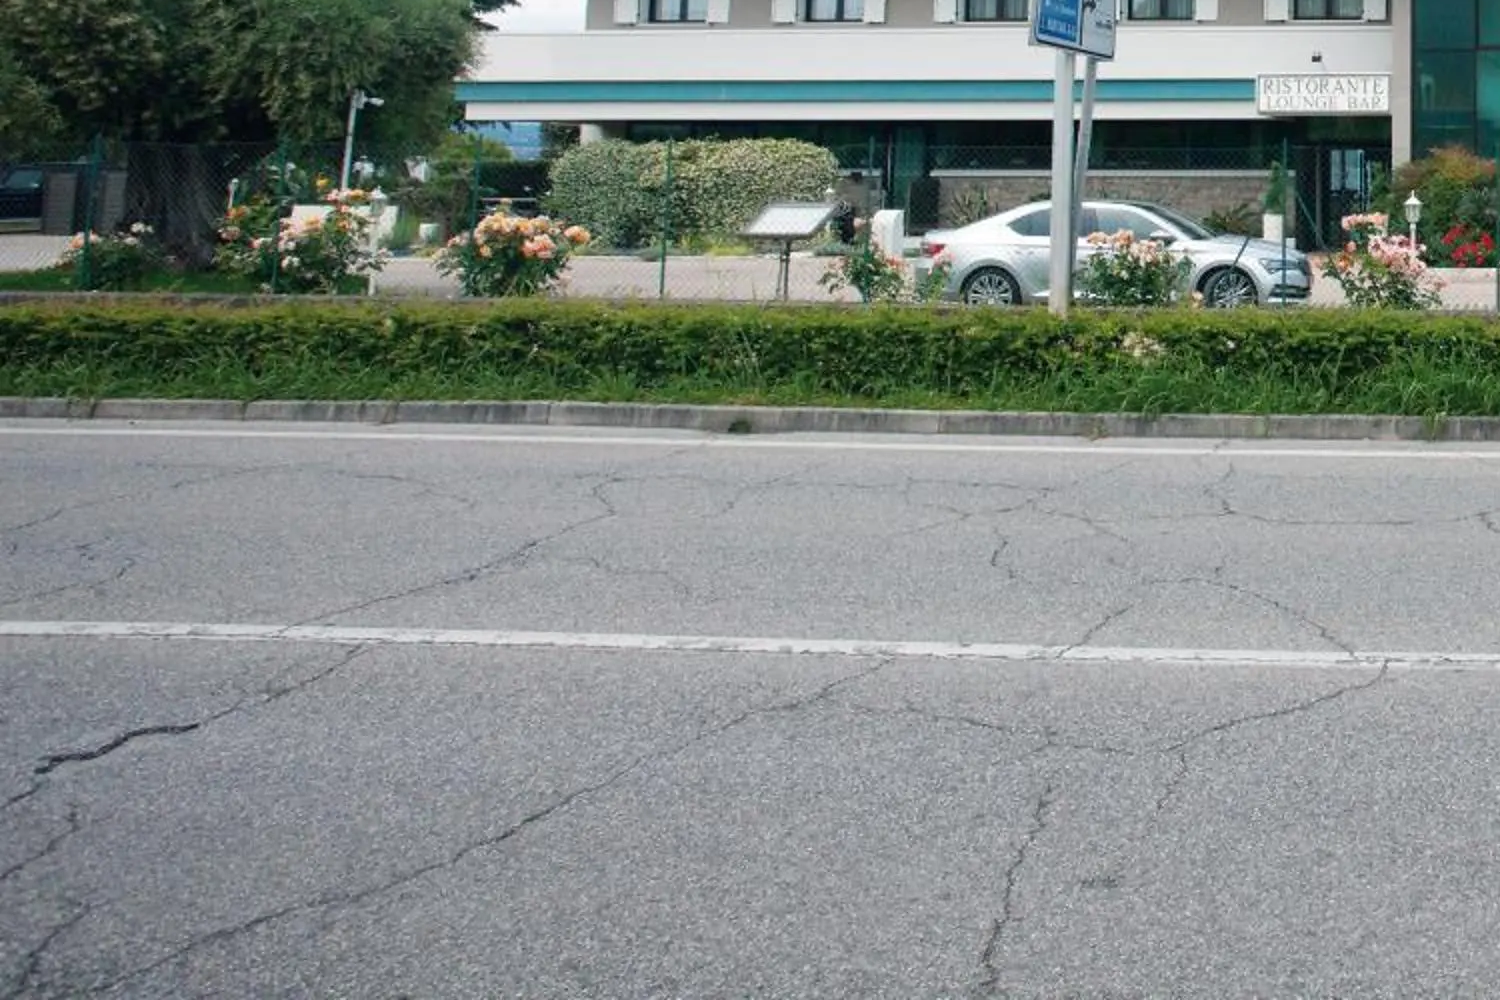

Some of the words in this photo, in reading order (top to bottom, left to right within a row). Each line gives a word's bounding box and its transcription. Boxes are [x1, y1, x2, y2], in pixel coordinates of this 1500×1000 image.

[1263, 78, 1385, 95] RISTORANTE
[1267, 95, 1338, 110] LOUNGE
[1347, 95, 1381, 110] BAR
